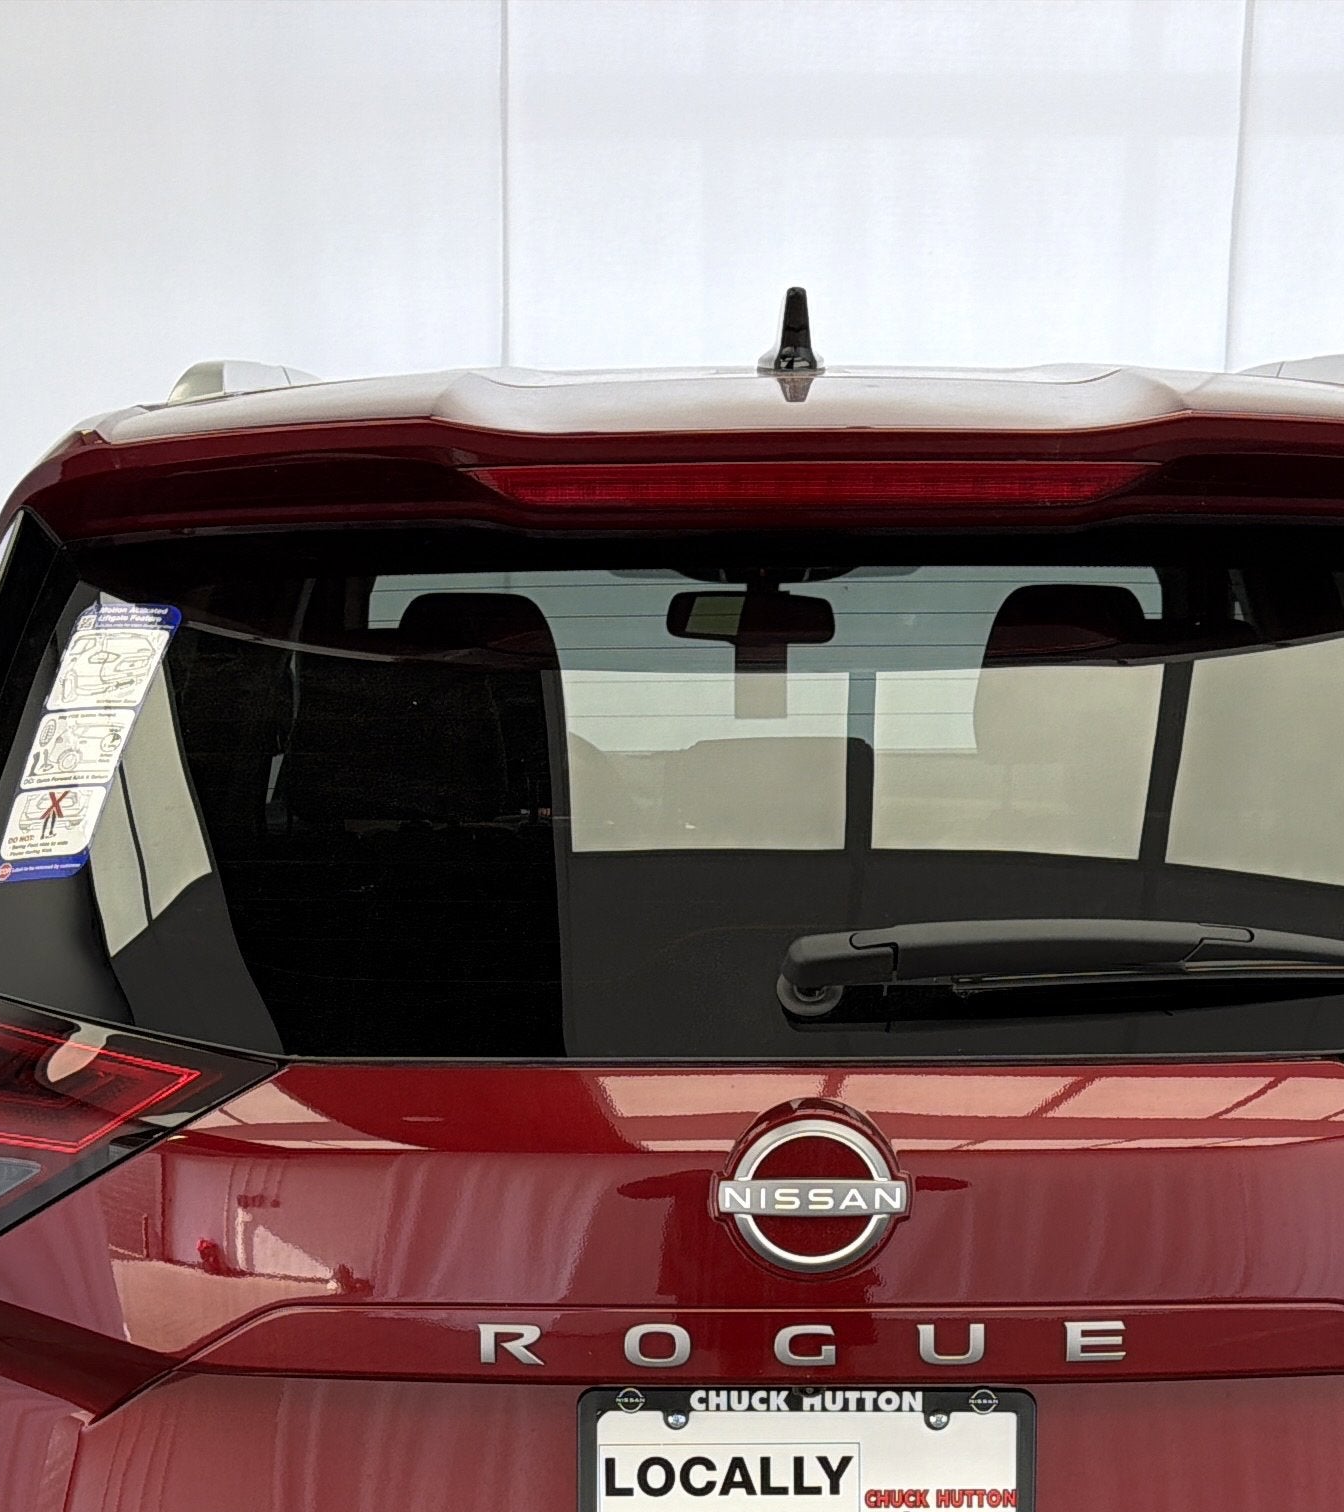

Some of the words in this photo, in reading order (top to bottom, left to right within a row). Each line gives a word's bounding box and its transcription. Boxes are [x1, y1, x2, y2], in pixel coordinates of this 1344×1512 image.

[723, 1186, 902, 1211] NISSAN
[477, 1319, 1127, 1368] ROGUE
[689, 1389, 790, 1412] CHUCK
[802, 1389, 923, 1413] HUTTON
[604, 1455, 854, 1498] LOCALLY
[864, 1488, 930, 1509] CHUCK
[936, 1488, 1018, 1509] HUTTON
